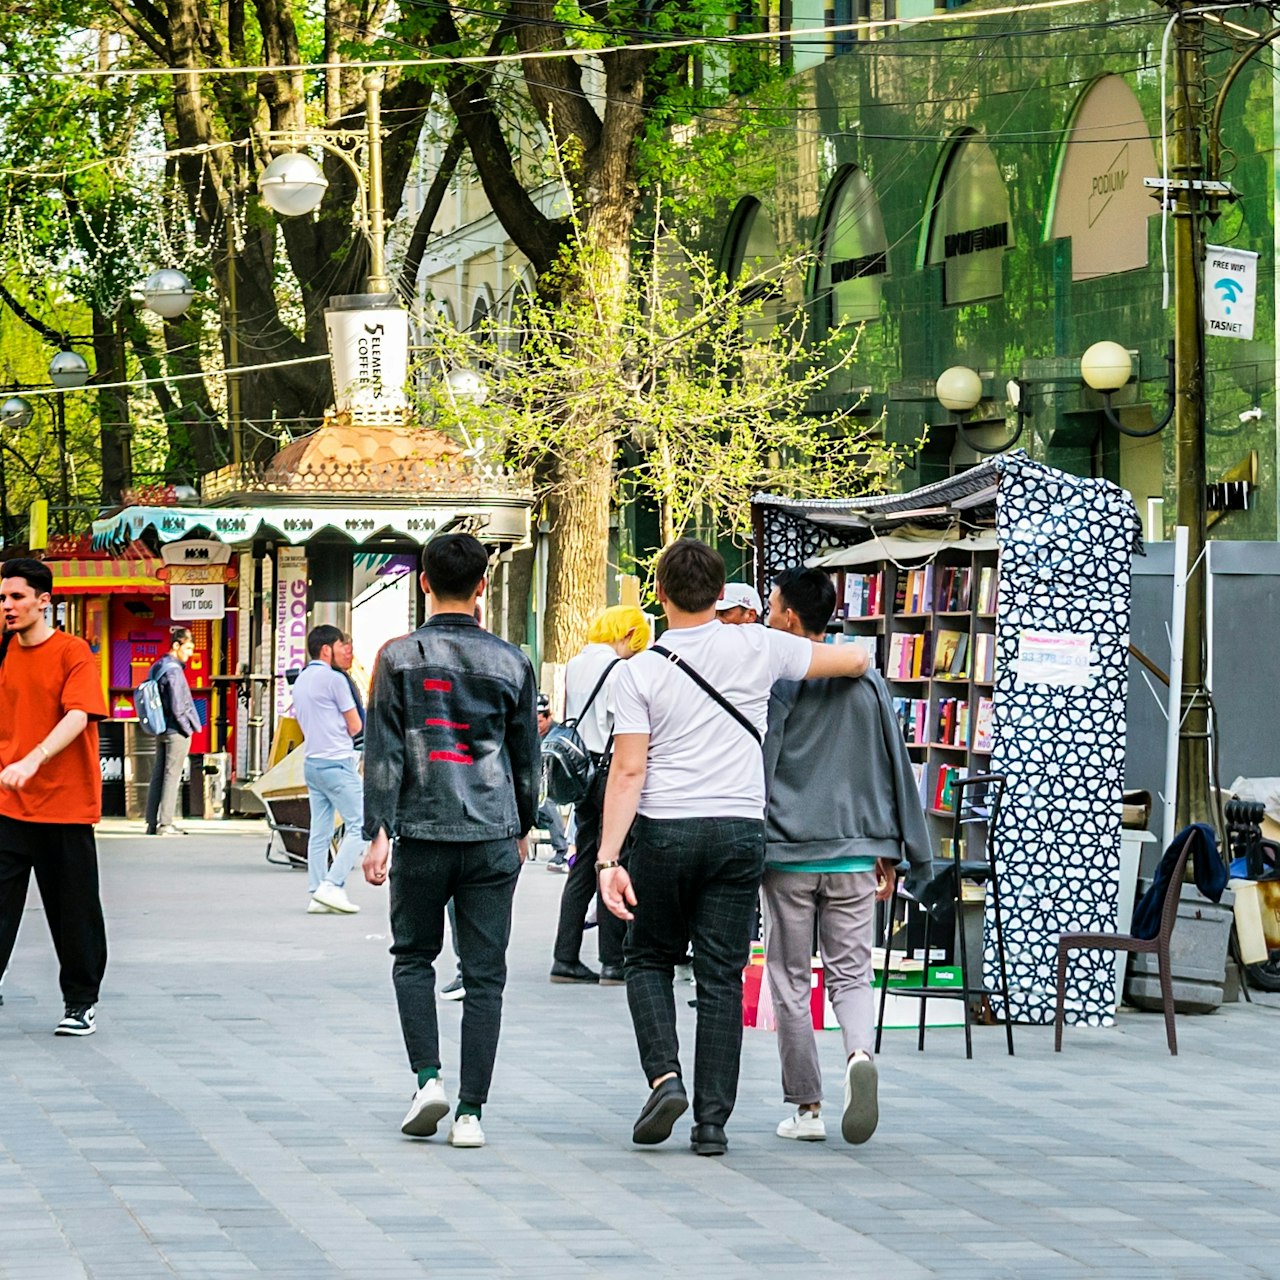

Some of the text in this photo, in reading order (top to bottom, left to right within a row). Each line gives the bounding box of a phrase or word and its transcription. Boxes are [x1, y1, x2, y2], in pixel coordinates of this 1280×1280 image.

[1213, 260, 1246, 273] FREE WIFI
[1210, 319, 1242, 334] TASNET
[358, 337, 370, 384] COFFEE
[190, 588, 205, 597] TOP
[182, 600, 213, 610] HOT DOG
[290, 578, 308, 638] DOG
